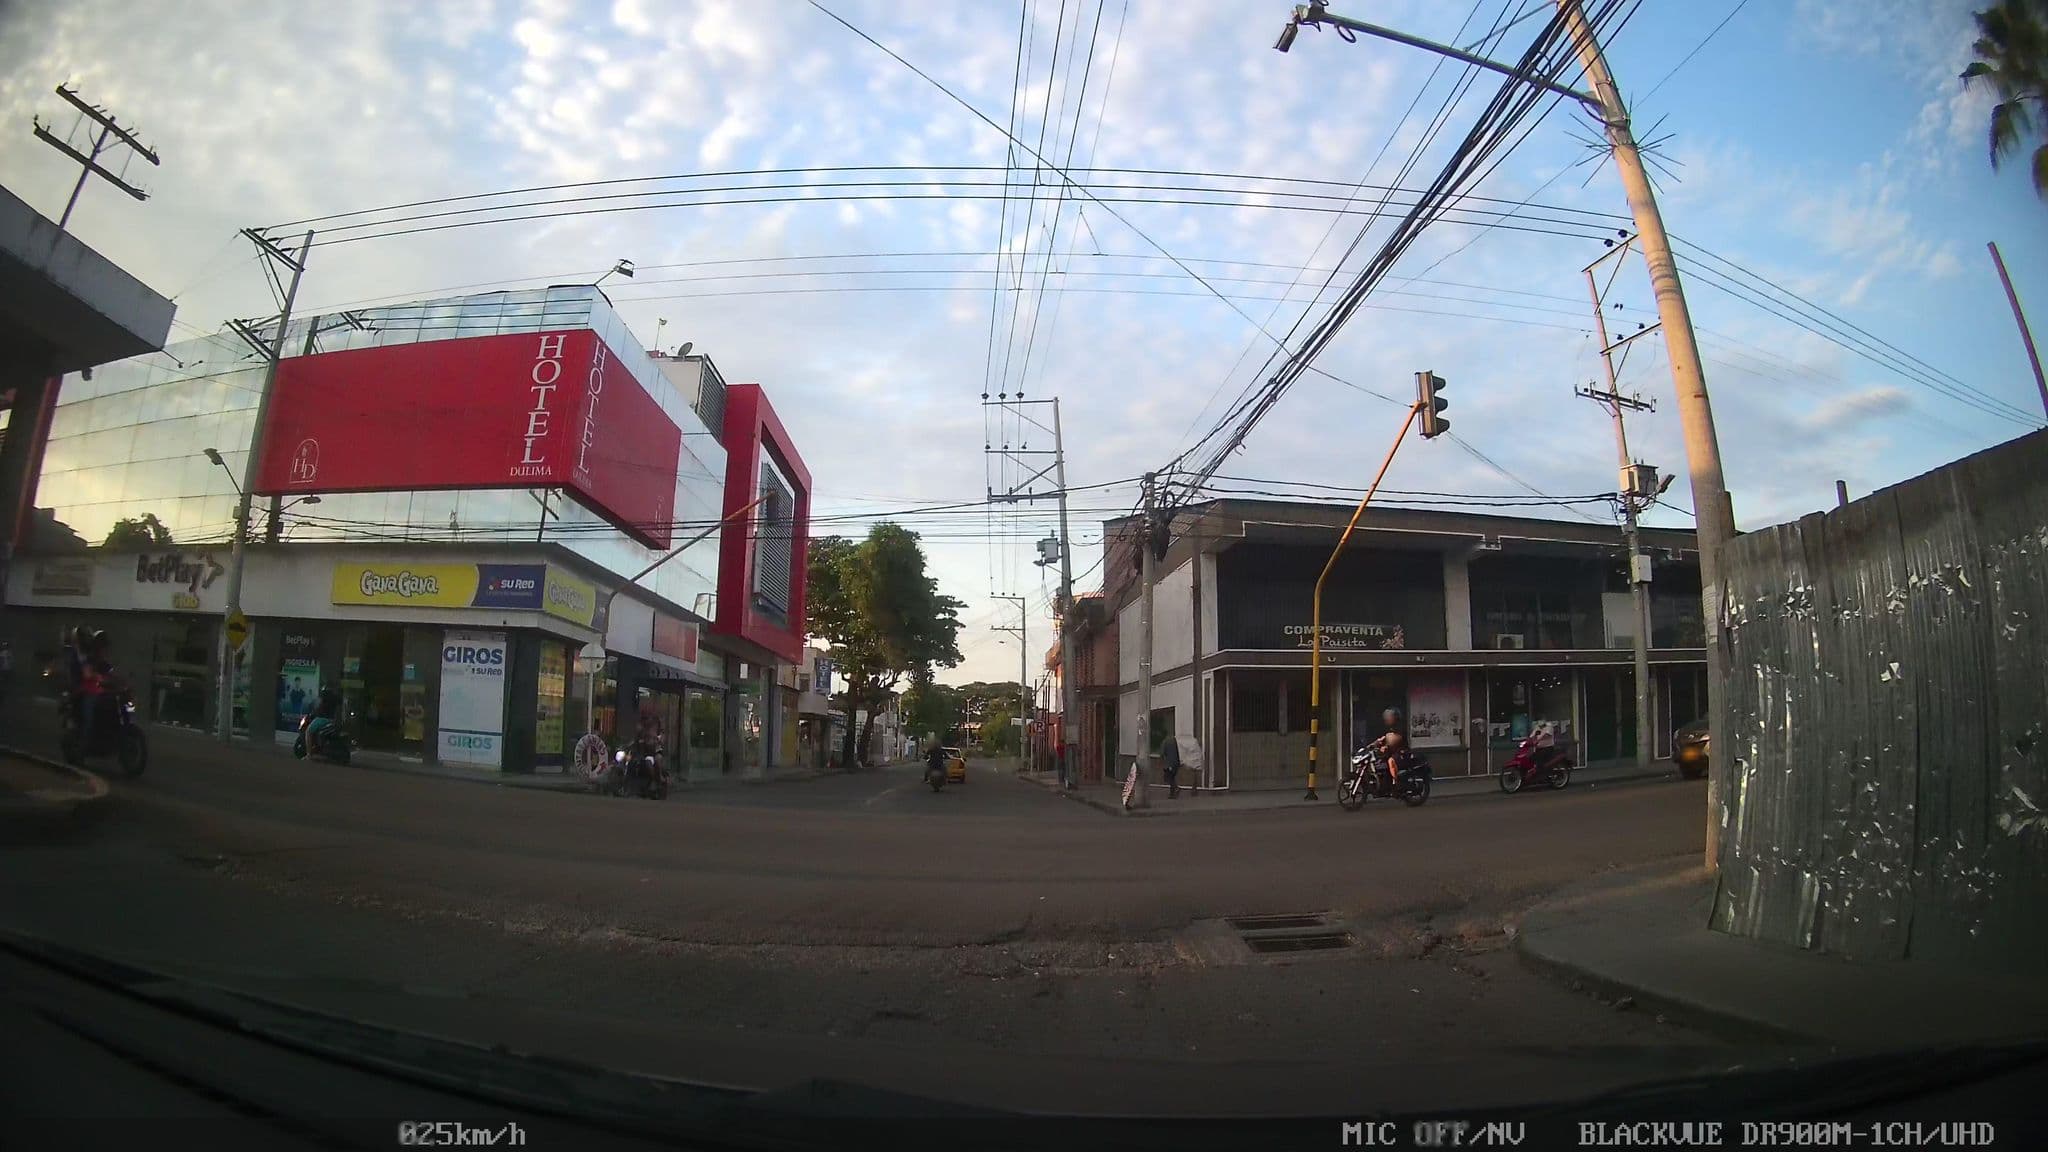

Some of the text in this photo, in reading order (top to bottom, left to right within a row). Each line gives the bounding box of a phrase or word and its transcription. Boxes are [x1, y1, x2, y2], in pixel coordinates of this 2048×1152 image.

[521, 334, 567, 465] HOTEL
[577, 340, 606, 474] HOTEL
[510, 465, 553, 477] DULIMA
[137, 554, 206, 593] BetPlay
[1284, 625, 1384, 637] COMPRAVENTA
[1317, 636, 1369, 649] Paisita
[443, 646, 503, 665] GIROS
[447, 735, 494, 750] GIROS
